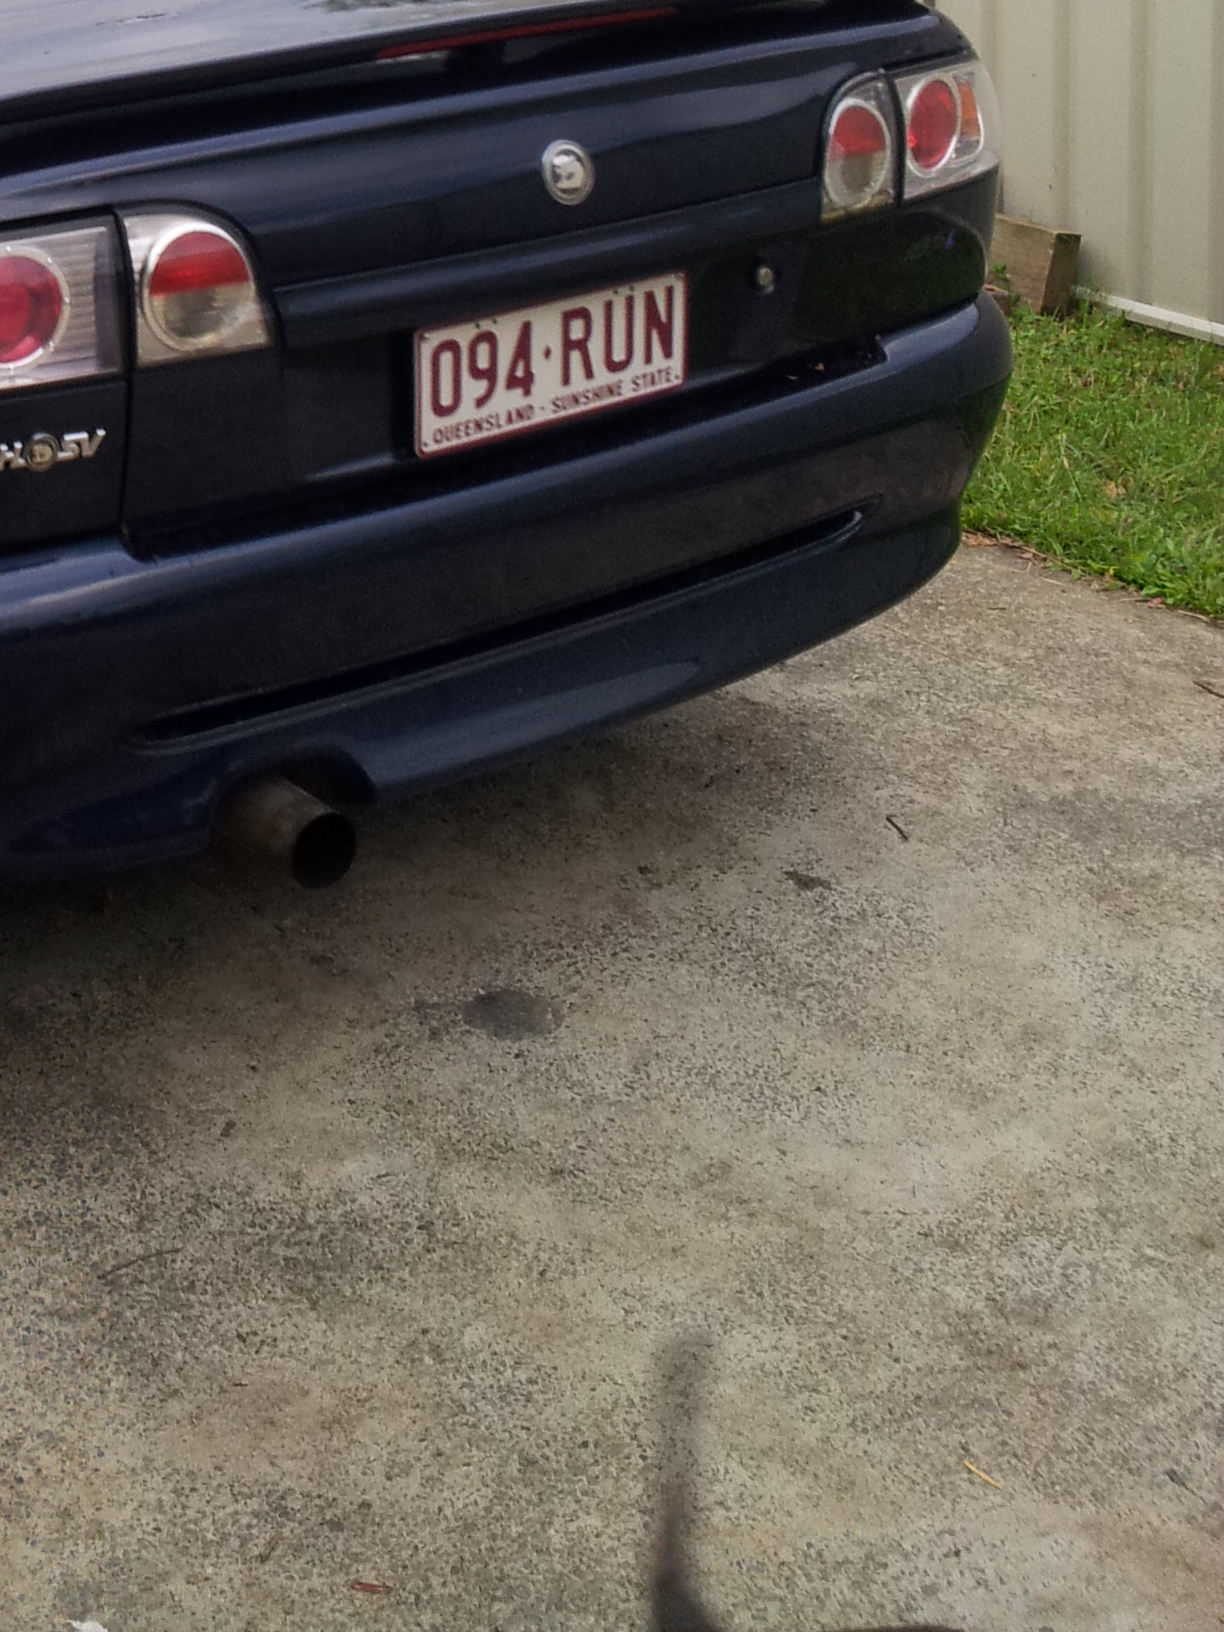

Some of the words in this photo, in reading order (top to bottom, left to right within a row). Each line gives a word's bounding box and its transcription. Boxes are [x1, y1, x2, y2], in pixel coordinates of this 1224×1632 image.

[432, 403, 535, 445] QUEENSLAND
[550, 378, 623, 414] SUNSHINE
[631, 366, 673, 392] STATE
